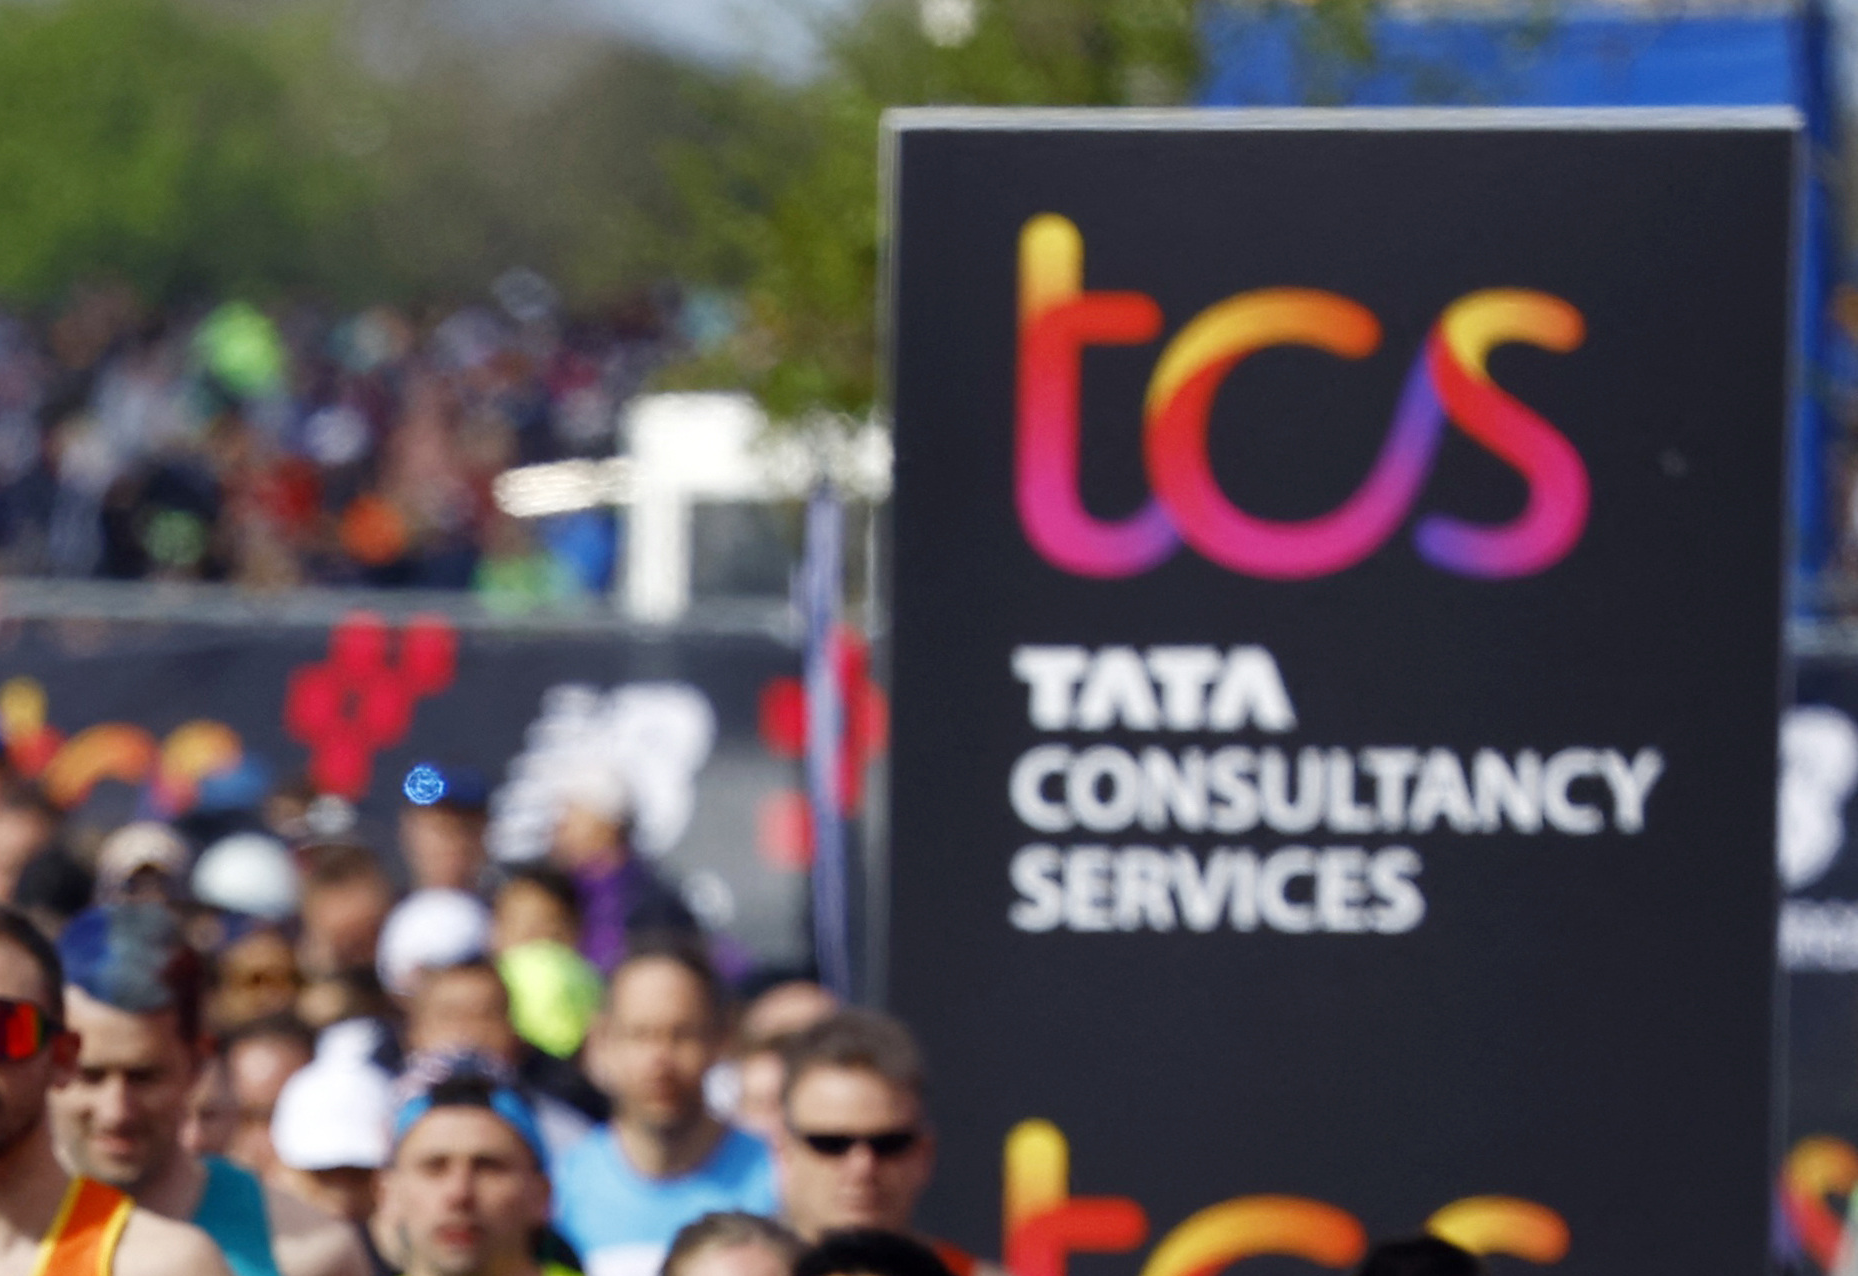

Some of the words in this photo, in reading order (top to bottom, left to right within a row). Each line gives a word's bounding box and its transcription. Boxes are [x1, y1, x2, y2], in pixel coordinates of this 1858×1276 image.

[1013, 212, 1592, 579] tcs
[1010, 643, 1297, 732] TATA
[1007, 745, 1665, 836] CONSULTANCY
[1007, 845, 1428, 935] SERVICES
